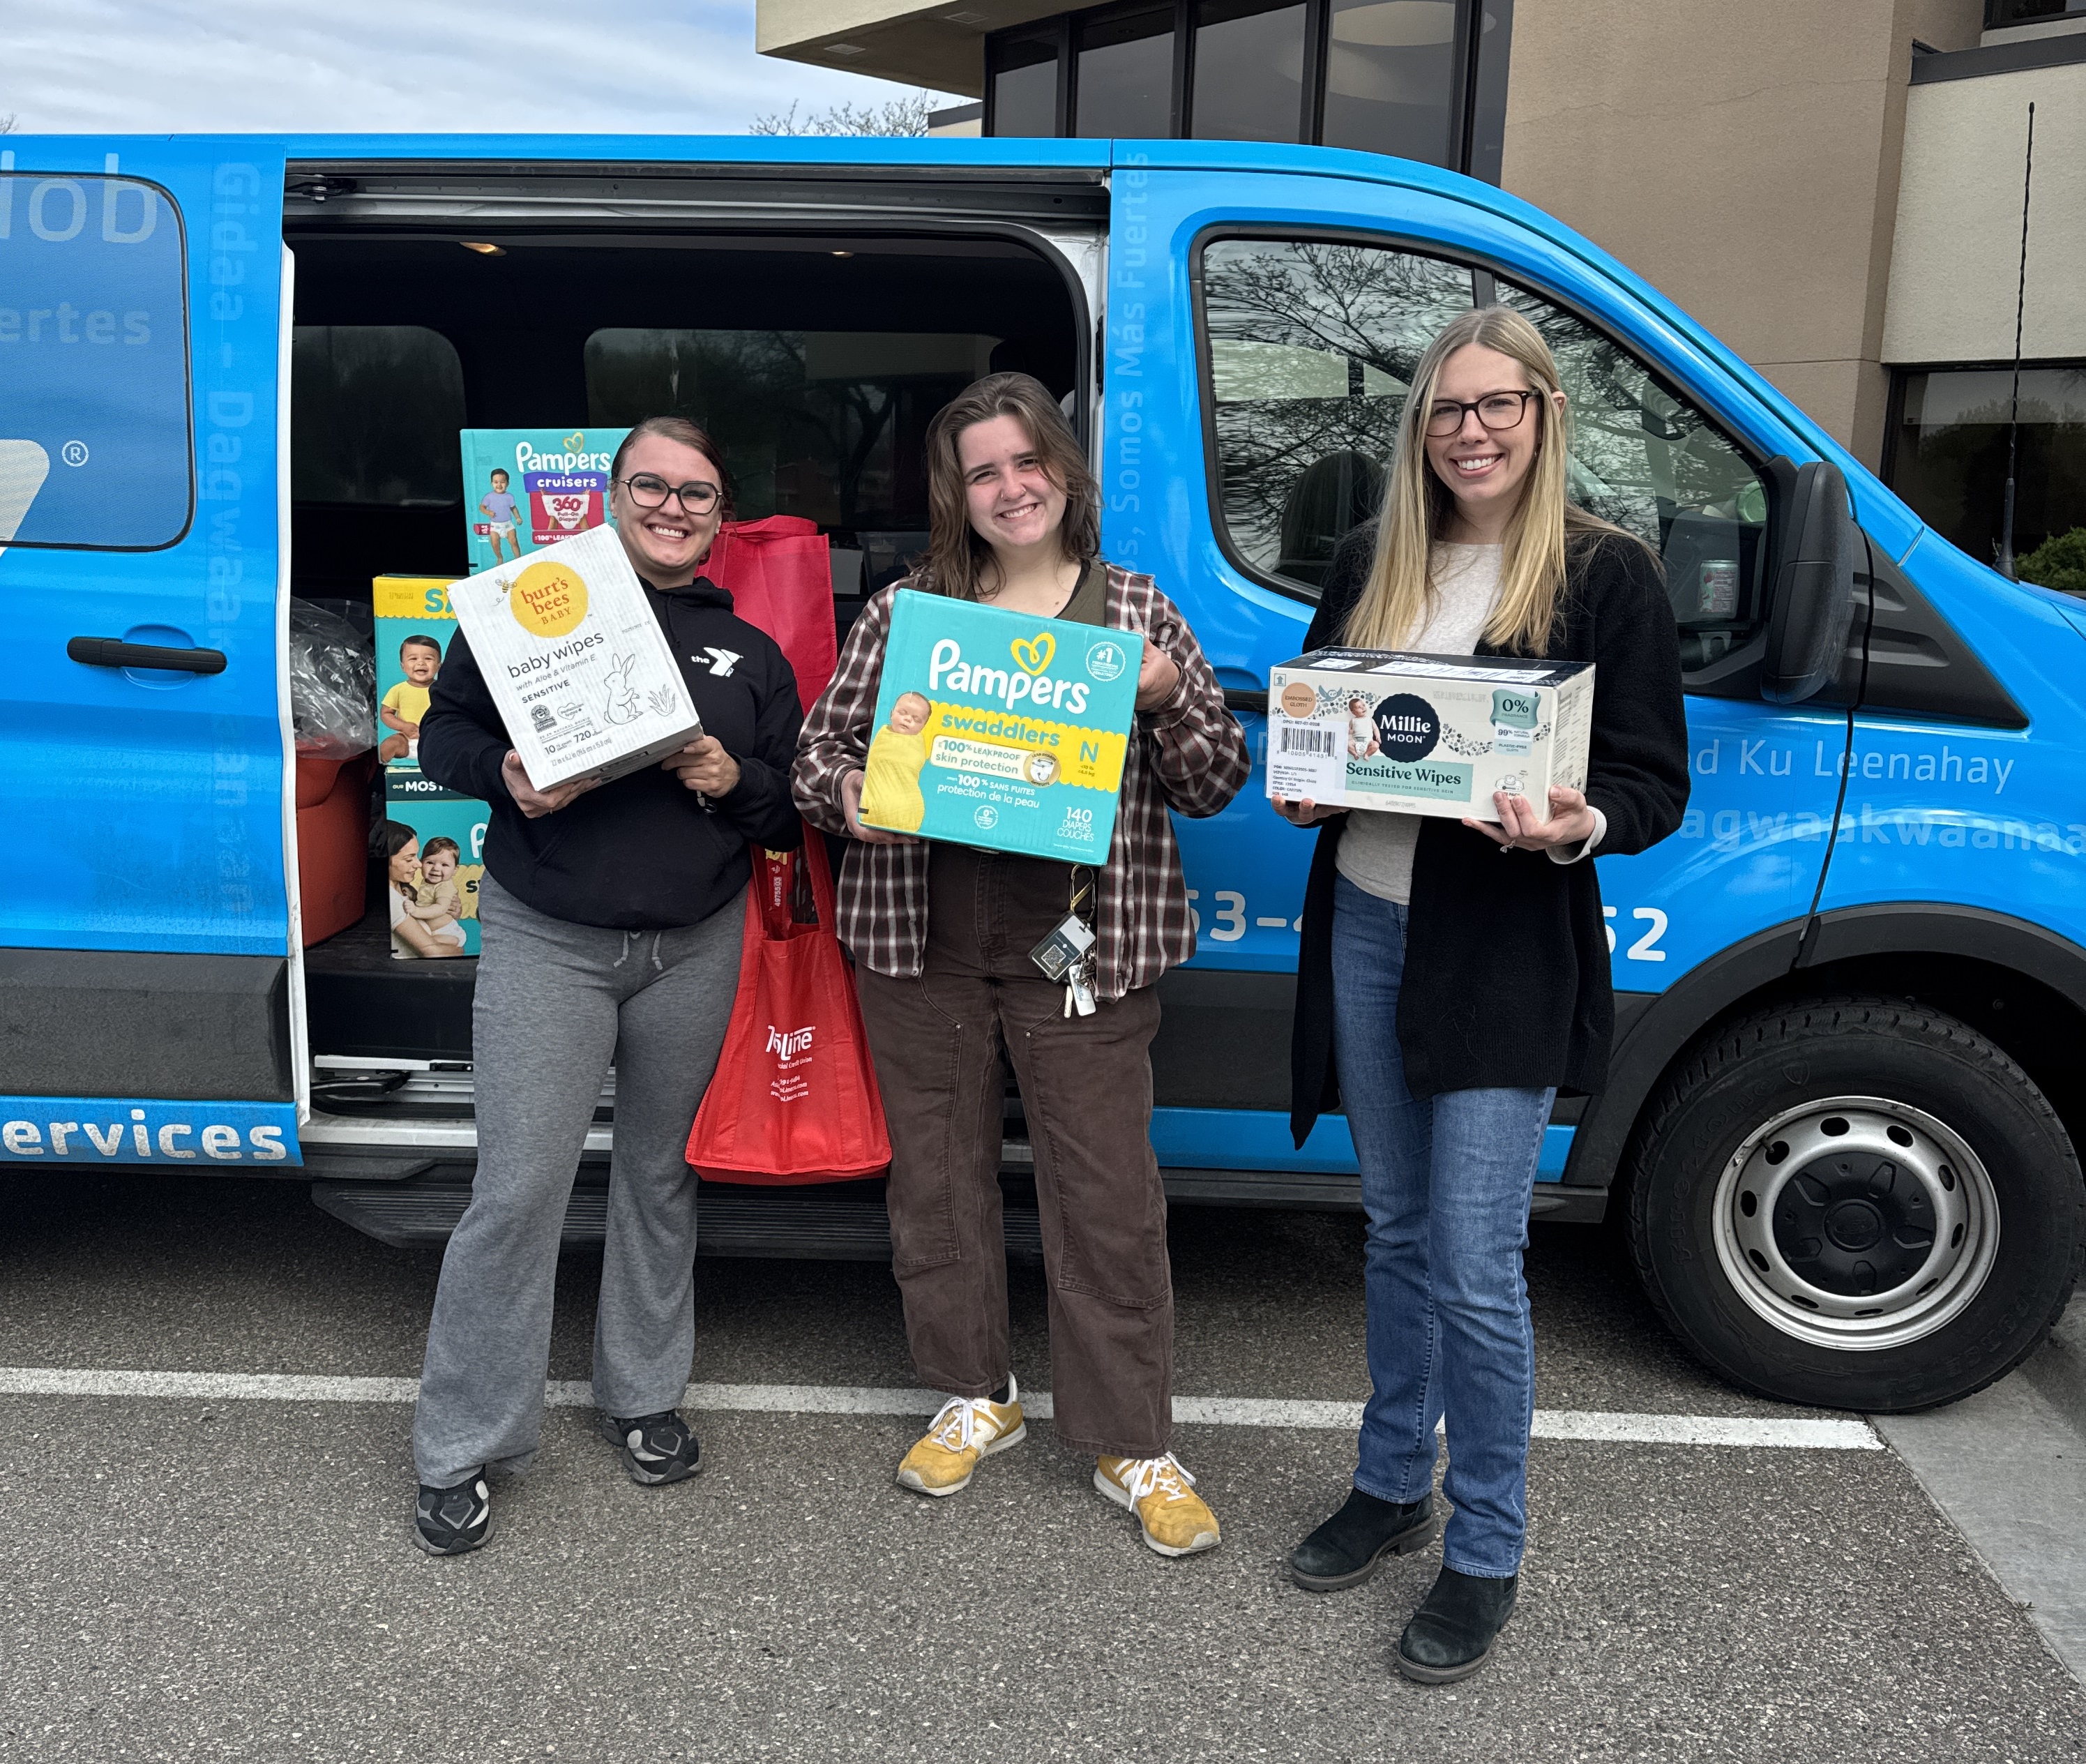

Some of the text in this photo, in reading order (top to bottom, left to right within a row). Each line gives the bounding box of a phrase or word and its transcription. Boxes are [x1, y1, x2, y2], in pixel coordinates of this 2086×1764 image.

[1117, 153, 1147, 289] Fuertes
[211, 163, 260, 322] Gidaa
[1112, 303, 1145, 377] Más
[516, 442, 611, 476] Pampers
[1111, 393, 1143, 514] Somos
[537, 476, 597, 488] cruisers
[531, 594, 569, 615] bees
[541, 607, 570, 625] BABY
[507, 633, 604, 678] baby wipes
[1096, 647, 1113, 663] #1
[516, 680, 533, 691] with
[535, 673, 552, 684] Aloe
[560, 657, 589, 673] Vitamin
[928, 639, 1090, 714] Pampers
[522, 679, 570, 704] SENSITIVE
[1502, 699, 1529, 713] 0%
[1380, 715, 1431, 733] Millie
[545, 730, 591, 755] 10 720
[942, 714, 1099, 763] swaddlers N
[936, 752, 1018, 775] skin protection
[974, 747, 1021, 761] LEAKPROOF
[1346, 762, 1461, 786] Sensitive Wipes
[1740, 740, 1792, 776] Ku
[1814, 741, 2015, 794] Leenahay
[937, 784, 1040, 808] protection de la peau
[990, 782, 1009, 791] SANS
[1011, 785, 1035, 796] FUITES
[1062, 820, 1091, 832] DIAPERS
[1066, 806, 1093, 823] 140
[1057, 827, 1094, 842] COUCHES
[2, 1109, 287, 1160] ervices
